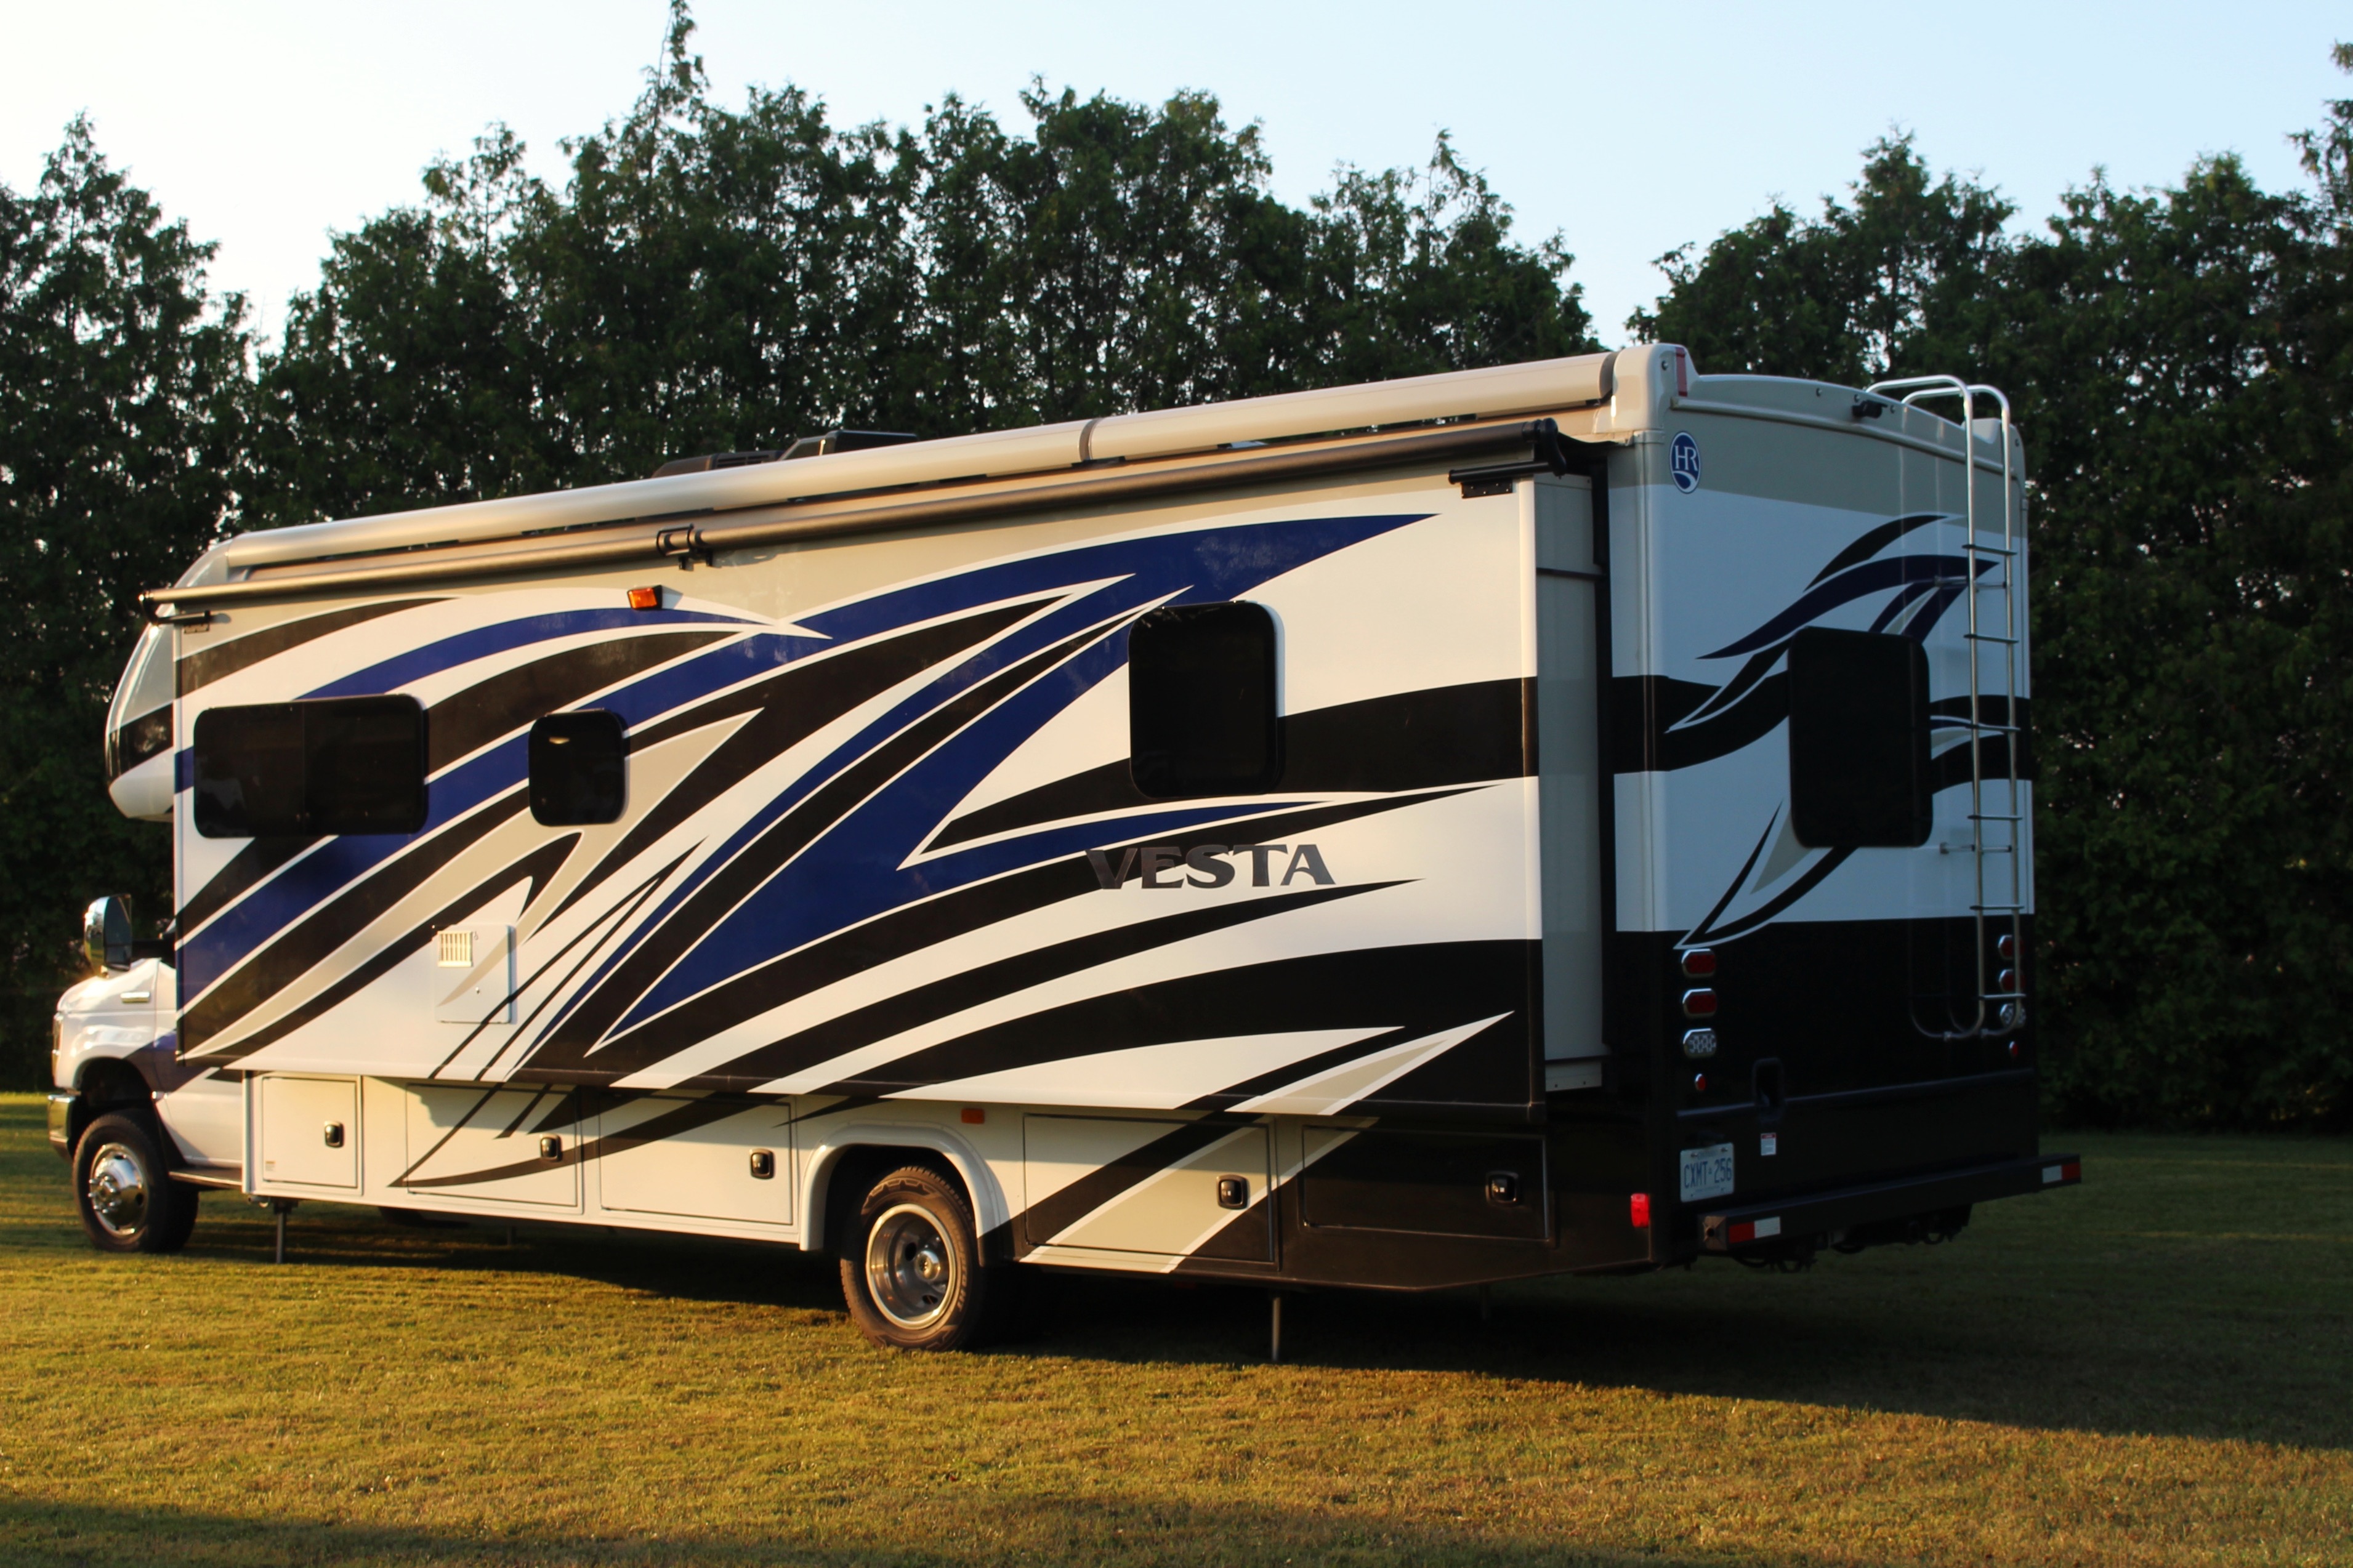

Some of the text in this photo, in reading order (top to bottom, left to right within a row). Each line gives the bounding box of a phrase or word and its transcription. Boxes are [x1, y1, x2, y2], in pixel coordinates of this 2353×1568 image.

[1674, 445, 1698, 472] HR
[1084, 844, 1336, 890] VESTA
[1714, 1157, 1732, 1183] 256
